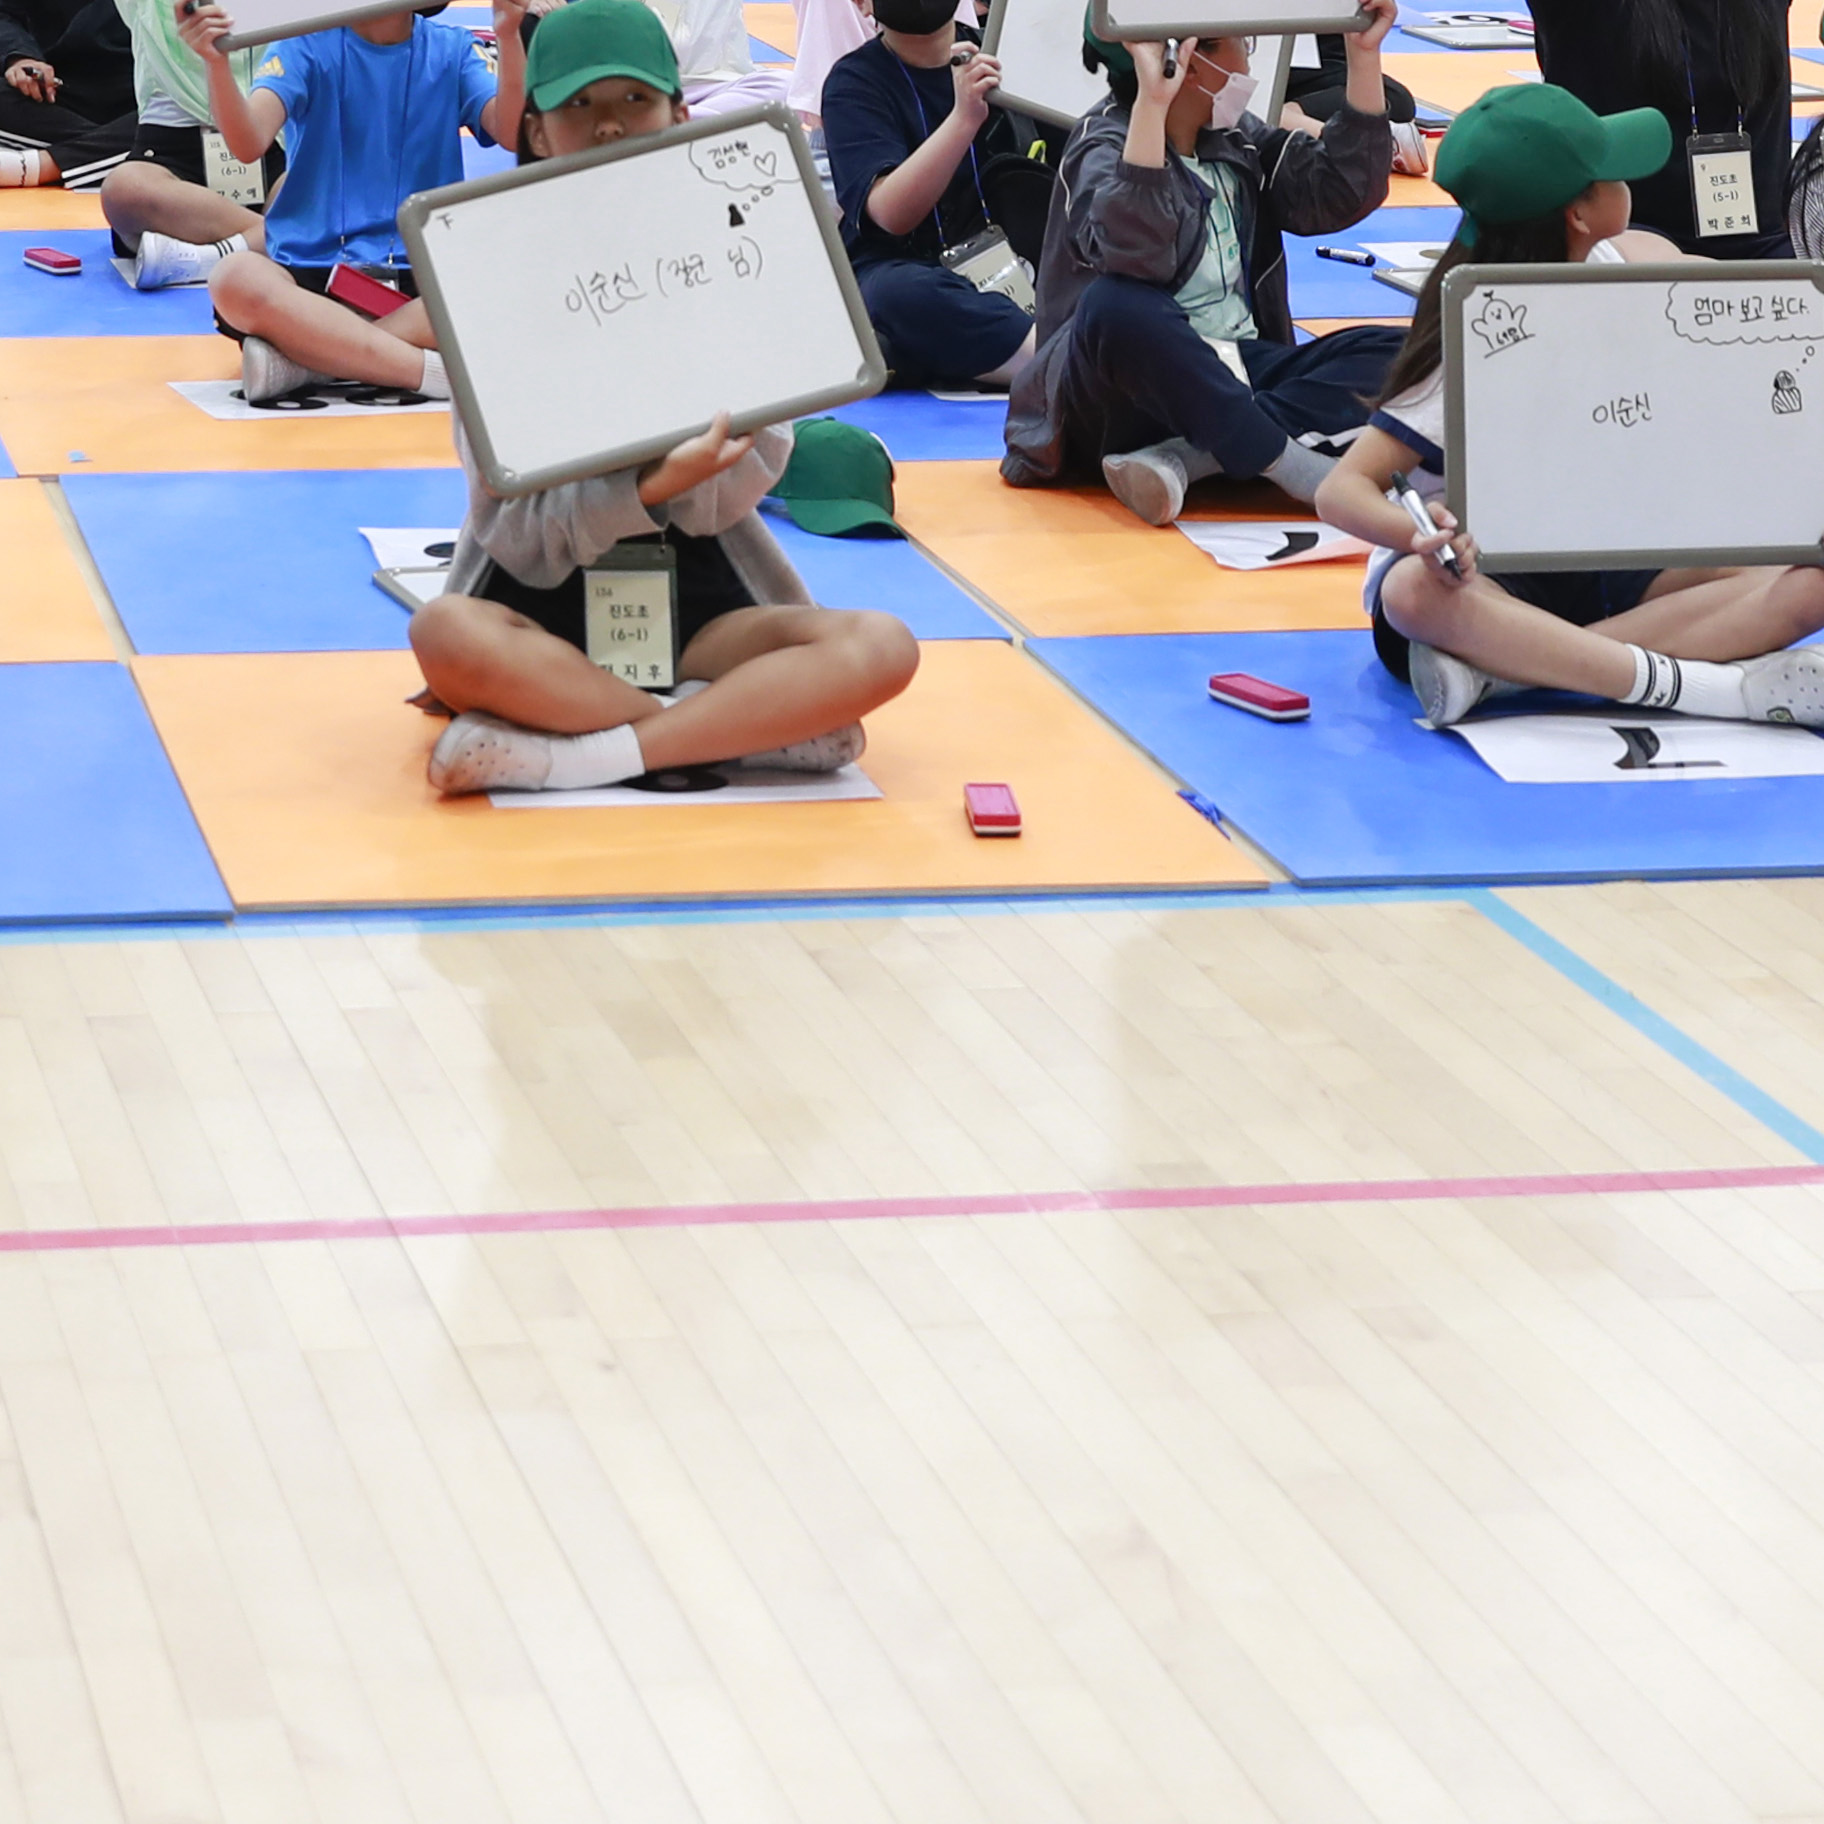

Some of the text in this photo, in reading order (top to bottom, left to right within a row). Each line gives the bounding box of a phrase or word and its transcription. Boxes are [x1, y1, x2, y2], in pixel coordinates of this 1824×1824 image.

[219, 151, 237, 162] 진도
[705, 140, 753, 171] 김성현
[220, 165, 247, 177] (6-1)
[1709, 174, 1739, 186] 진도초
[1712, 190, 1739, 203] (5-1)
[1707, 215, 1752, 231] 박준희
[565, 263, 648, 327] 이순신
[728, 235, 763, 281] 님)
[1693, 295, 1811, 326] 엄마 보고 싶다.
[1592, 391, 1653, 428] 이순신
[609, 604, 650, 619] 진도초
[609, 627, 649, 643] (6-1)
